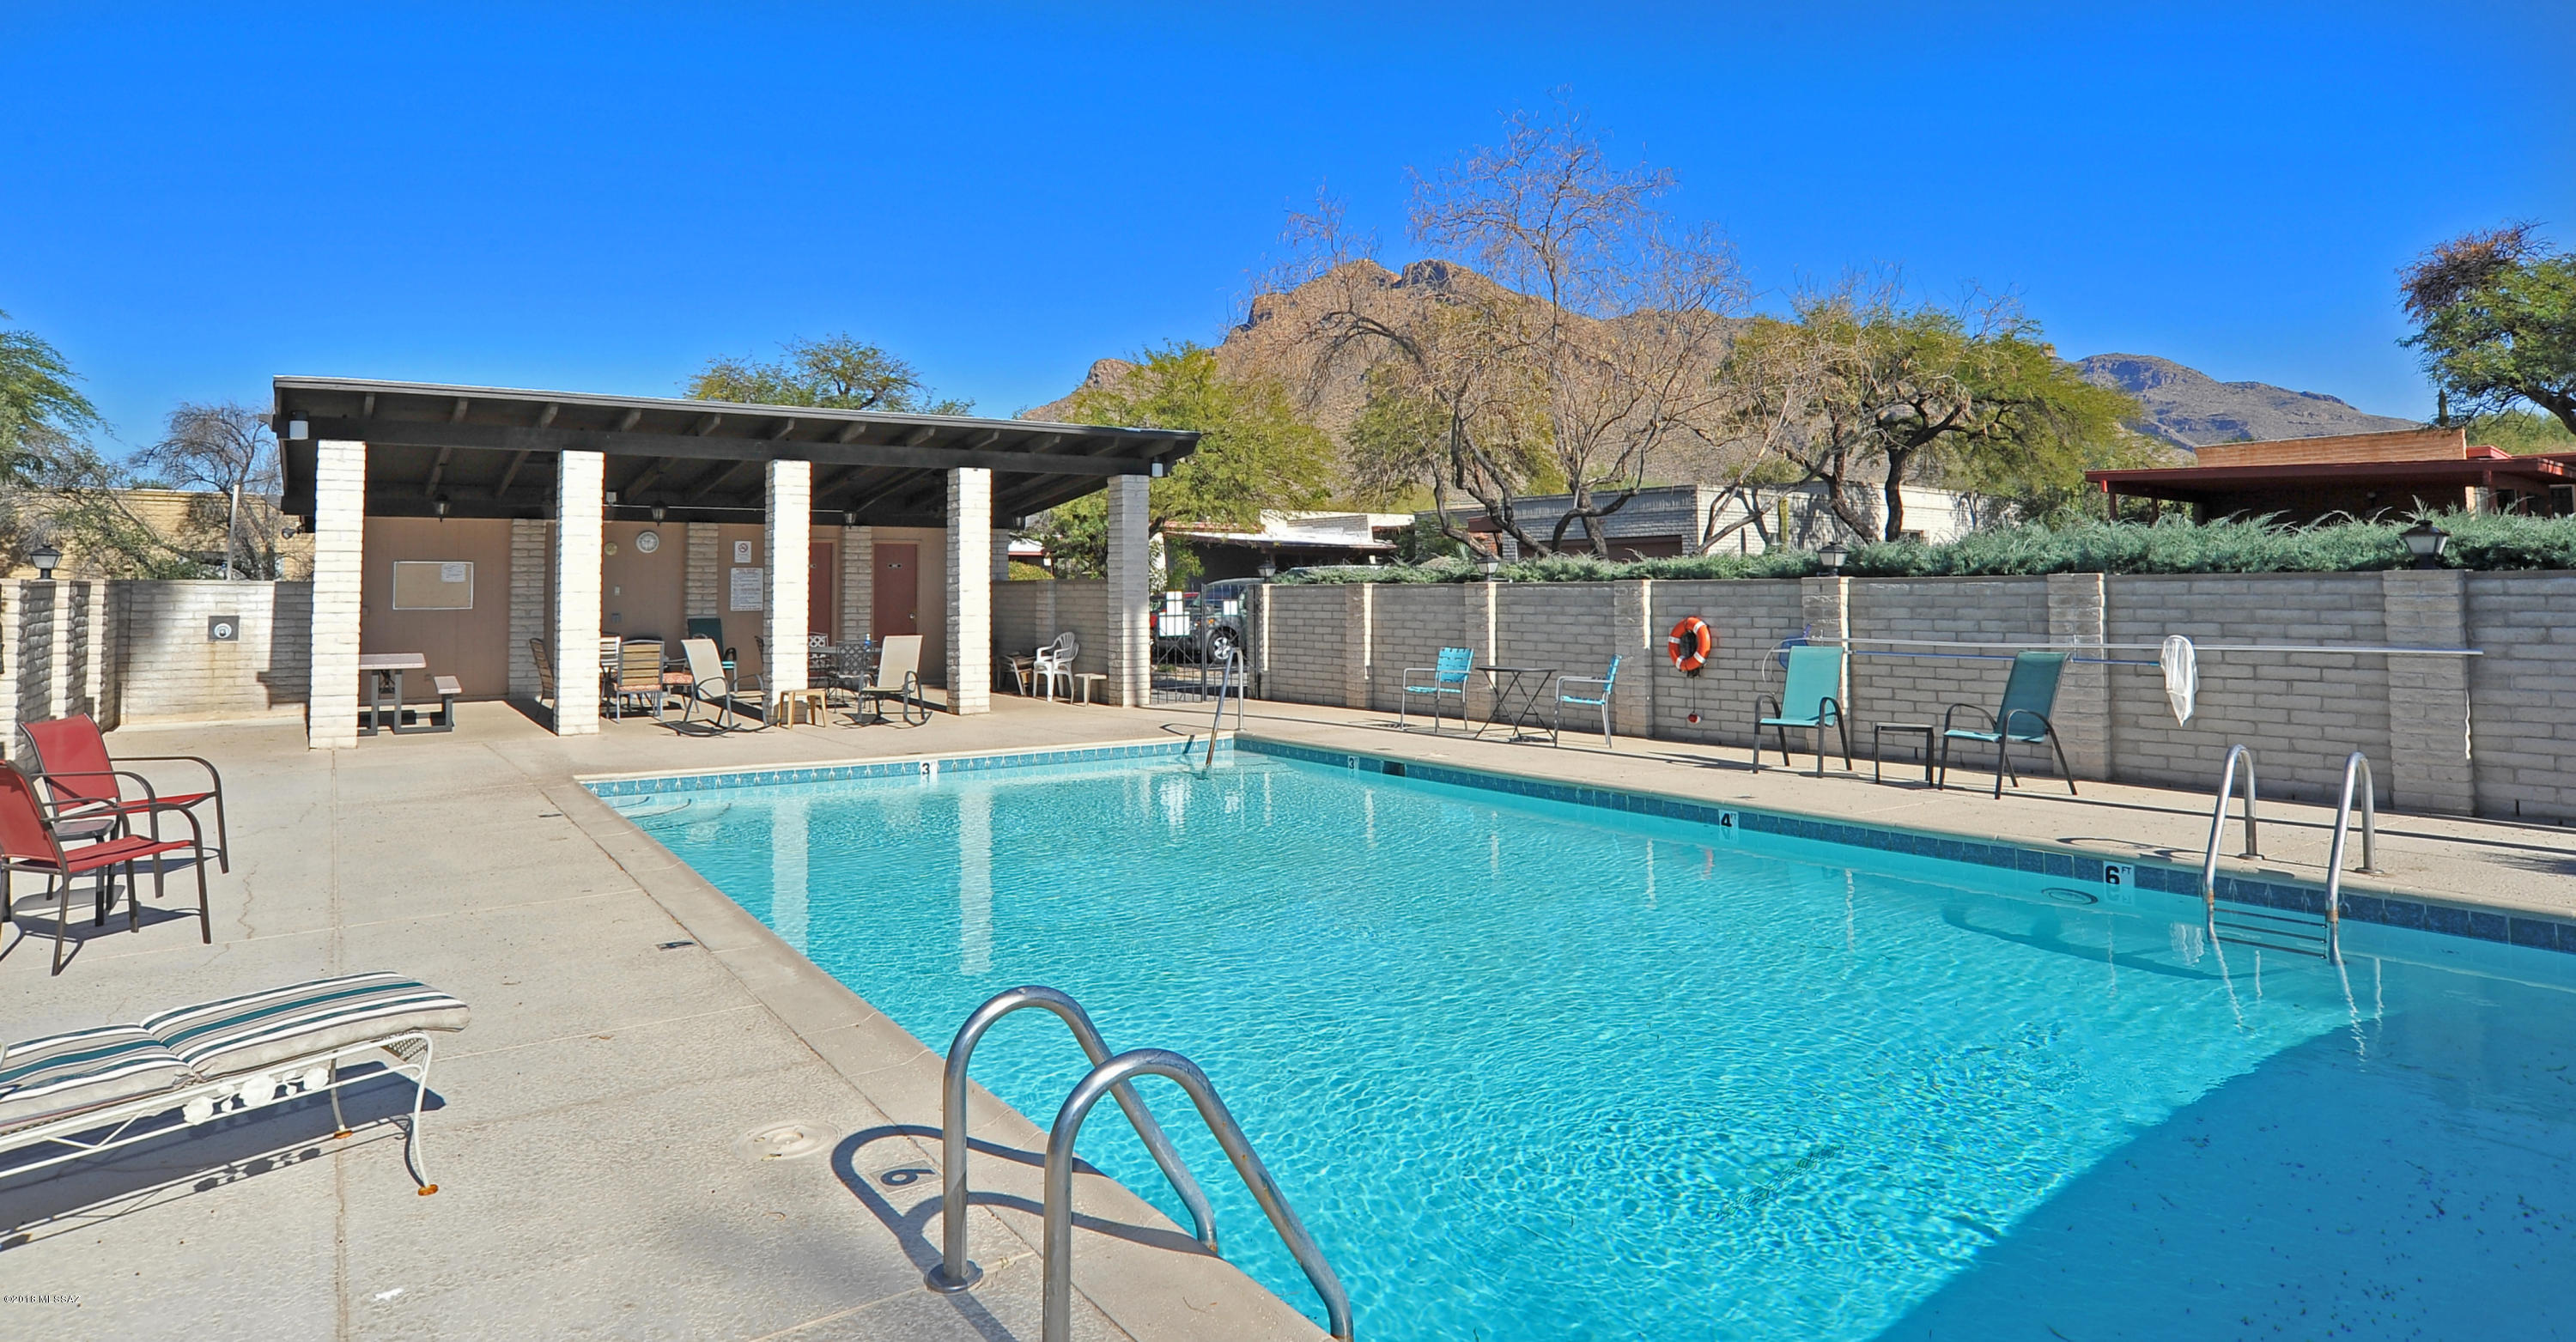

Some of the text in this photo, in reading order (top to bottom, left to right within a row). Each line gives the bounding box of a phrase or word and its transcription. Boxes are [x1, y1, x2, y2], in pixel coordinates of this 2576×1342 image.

[922, 762, 930, 775] 3
[1349, 757, 1355, 769] 3
[1721, 812, 1733, 827] 4
[2105, 865, 2120, 885] 6
[880, 1169, 936, 1187] 6
